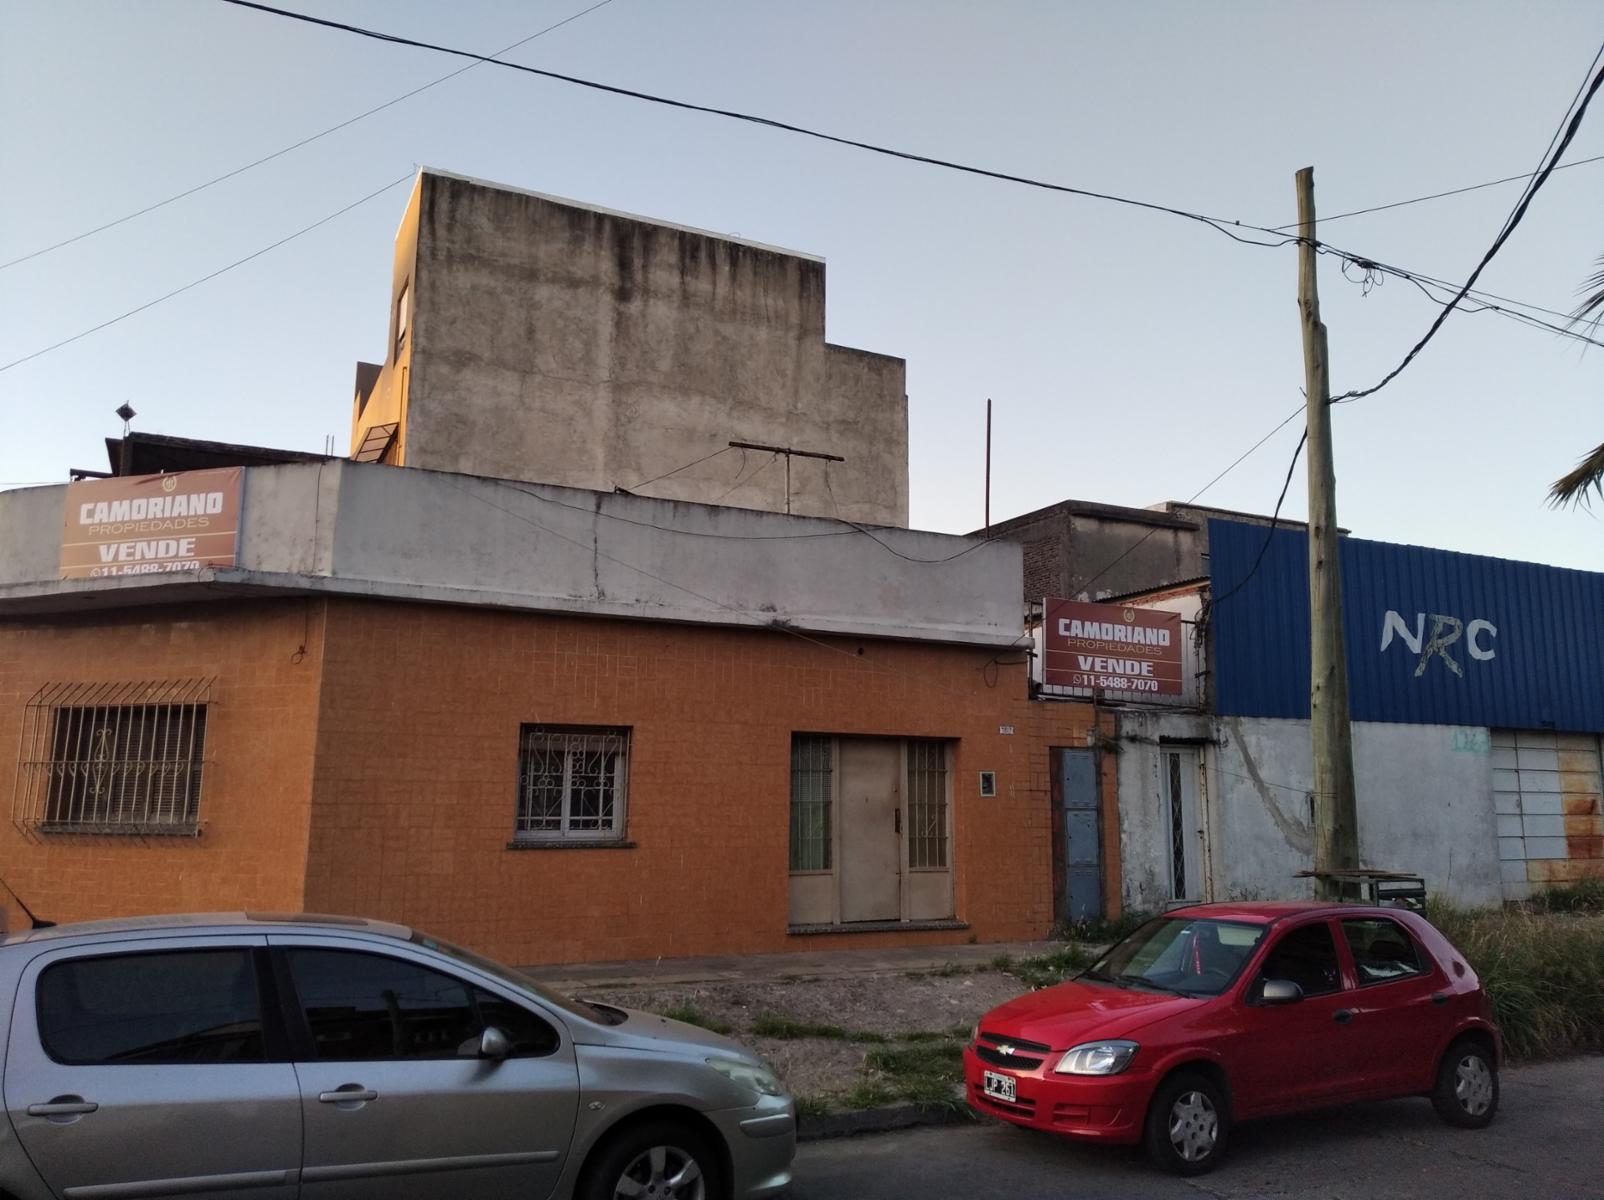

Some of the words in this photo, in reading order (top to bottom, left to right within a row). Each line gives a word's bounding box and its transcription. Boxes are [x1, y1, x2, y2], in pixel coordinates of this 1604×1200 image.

[80, 492, 224, 524] CAMORIANO
[88, 517, 210, 536] PROPIEDADES
[99, 538, 196, 562] VENDE
[1058, 618, 1170, 646] CAMORIANO
[1067, 639, 1162, 656] PROPIEDADES
[1380, 610, 1497, 678] NRC
[1077, 655, 1154, 677] VENDE
[1082, 674, 1158, 691] 11-5488-7070
[1001, 1081, 1014, 1097] 261
